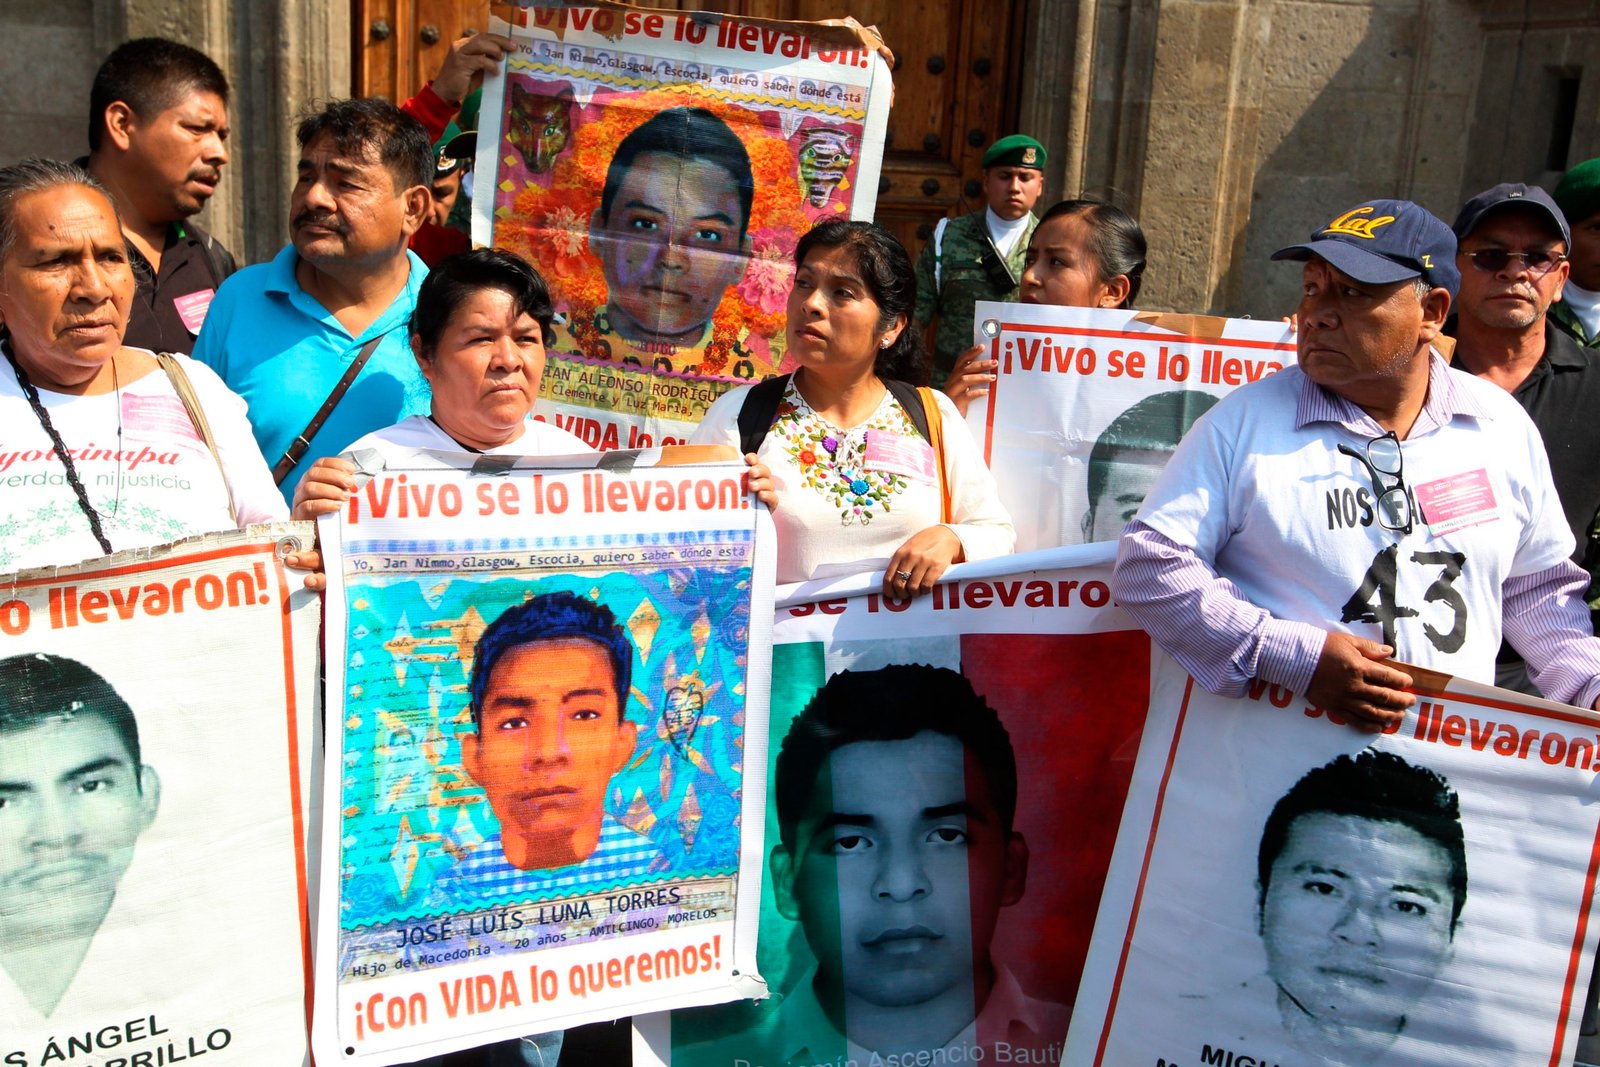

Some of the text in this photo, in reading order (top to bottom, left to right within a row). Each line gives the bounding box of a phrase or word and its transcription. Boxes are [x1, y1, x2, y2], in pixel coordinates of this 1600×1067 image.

[624, 12, 664, 38] se
[673, 15, 707, 44] lo
[519, 44, 537, 57] Yo,
[544, 48, 564, 59] Jan
[664, 66, 712, 83] Escocia,
[720, 74, 759, 87] quiero
[763, 80, 796, 92] saber
[801, 85, 832, 99] dónde
[837, 92, 861, 103] está
[1322, 206, 1395, 239] Cal
[578, 371, 644, 393] ALFONSO
[1003, 337, 1097, 375] ¡Vivo
[1107, 349, 1146, 378] se
[1157, 346, 1191, 382] lo
[551, 384, 606, 402] Clemente
[611, 396, 620, 407] y
[626, 397, 647, 409] Luz
[96, 471, 114, 486] ni
[120, 471, 192, 490] justicia
[347, 472, 749, 524] ¡Vivo se lo llevaron!
[1326, 486, 1374, 530] NOS
[353, 559, 374, 571] Yo,
[383, 558, 407, 569] Jan
[529, 553, 585, 566] Escocia,
[593, 553, 634, 565] quiero
[641, 551, 675, 561] saber
[680, 547, 712, 559] dónde
[719, 546, 745, 557] está
[48, 562, 270, 629] llevaron!
[932, 580, 1118, 610] llevaro
[1340, 543, 1467, 657] 43
[1413, 702, 1600, 772] llevaron!
[396, 886, 681, 948] JOSÉ LUÍS LUNA TORRES
[353, 963, 386, 977] Hijo
[395, 958, 411, 970] de
[419, 944, 491, 966] Macedonia
[514, 938, 530, 949] 20
[537, 932, 567, 946] años
[589, 918, 659, 938] AMILCINGO,
[668, 908, 717, 924] MORELOS
[355, 935, 722, 1041] ¡Con VIDA lo queremos!
[40, 1015, 169, 1067] ÁNGEL
[868, 1041, 984, 1067] Ascencio
